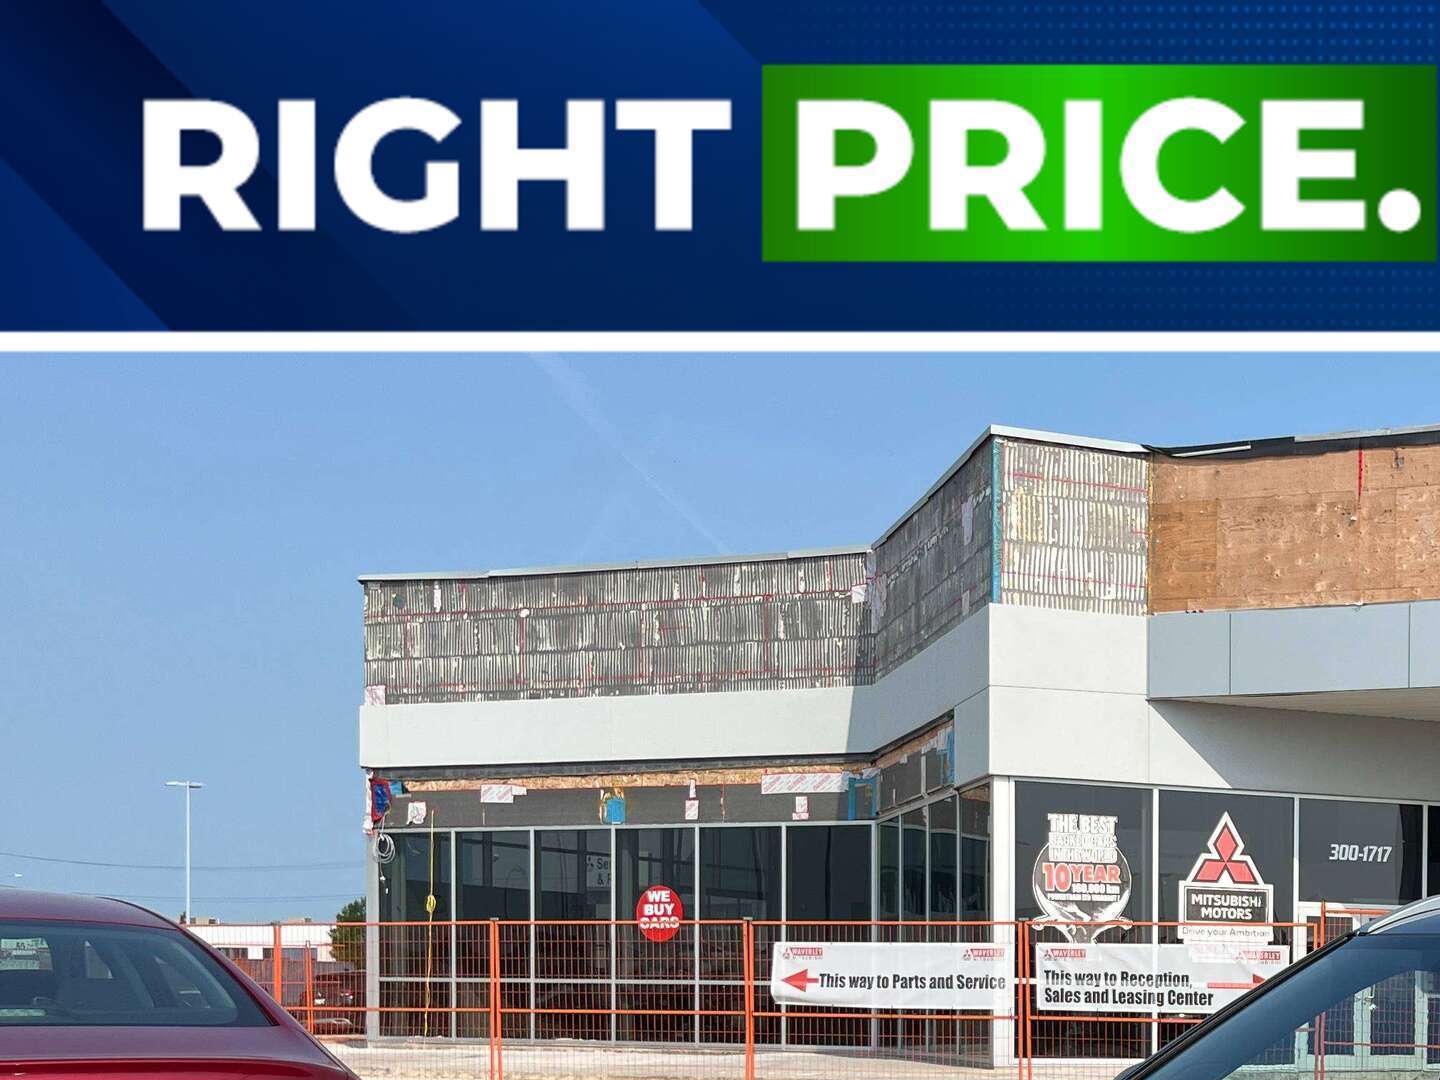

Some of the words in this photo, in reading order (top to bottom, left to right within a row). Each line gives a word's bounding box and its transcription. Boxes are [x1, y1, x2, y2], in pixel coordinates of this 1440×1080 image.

[1048, 813, 1078, 833] THE
[1079, 815, 1118, 834] BEST
[1329, 843, 1392, 863] 300-1717
[1042, 863, 1072, 892] 10
[1070, 864, 1121, 883] YEAR
[647, 890, 671, 902] WE
[1191, 893, 1262, 908] MITSUBISHI
[643, 903, 675, 916] BUY
[1201, 906, 1253, 920] MOTORS
[1182, 927, 1205, 935] Drive
[1208, 929, 1227, 937] your
[1230, 928, 1270, 937] Ambition
[819, 973, 846, 989] This
[849, 975, 873, 990] way
[877, 974, 889, 989] to
[893, 974, 926, 990] Parts
[929, 974, 953, 990] and
[957, 974, 1006, 991] Service
[1044, 970, 1072, 985] This
[1074, 973, 1101, 988] way
[1104, 971, 1117, 986] to
[1120, 971, 1193, 989] Reception,
[1044, 988, 1081, 1004] Sales
[1084, 988, 1108, 1004] and
[1112, 989, 1164, 1006] Leasing
[1167, 990, 1214, 1007] Center
